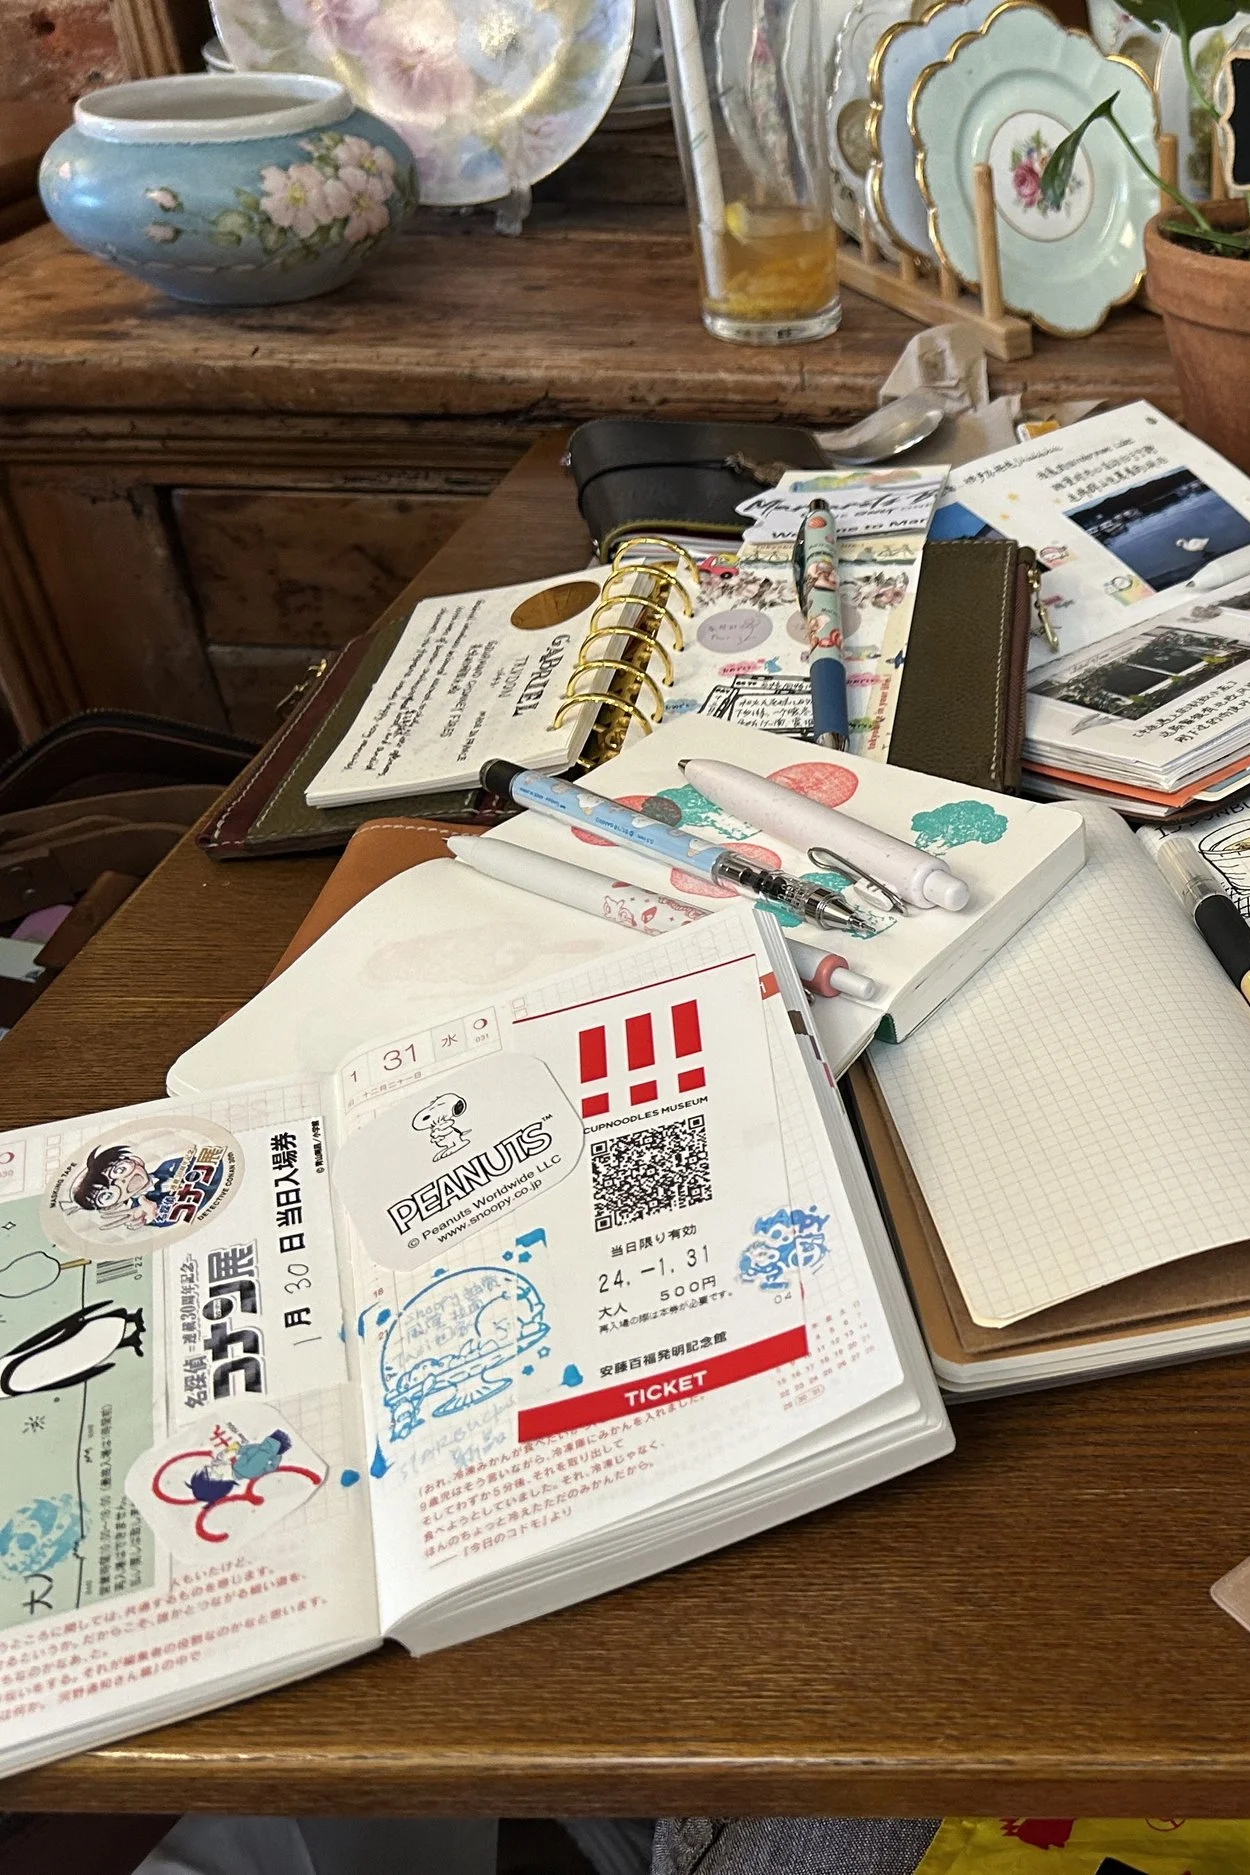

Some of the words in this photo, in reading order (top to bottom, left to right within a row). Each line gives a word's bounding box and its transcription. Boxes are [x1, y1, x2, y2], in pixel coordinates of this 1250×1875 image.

[513, 633, 570, 718] GABRIEL
[350, 1070, 358, 1083] 1
[382, 1043, 418, 1072] 31
[441, 1033, 458, 1048] 水
[583, 1110, 660, 1135] CUPNOODLES
[660, 1096, 710, 1115] MUSEUM
[50, 1175, 65, 1208] MASKING
[61, 1162, 77, 1180] TAPE
[197, 1186, 227, 1221] DETECTIVE
[225, 1165, 236, 1187] CONAN
[270, 1131, 303, 1228] 当日入場券
[387, 1121, 553, 1235] PEANUTS
[422, 1207, 472, 1241] Peanuts
[472, 1171, 536, 1210] Worldwide
[535, 1154, 562, 1177] LLC
[436, 1178, 543, 1245] www.snoopy.co.jp
[279, 1233, 306, 1253] 日
[610, 1223, 698, 1258] 当日限り有効
[686, 1244, 710, 1268] 31
[284, 1263, 312, 1294] 30
[203, 1241, 266, 1401] コナン展
[284, 1307, 312, 1328] 月
[598, 1303, 629, 1320] 大人
[599, 1331, 728, 1379] 安藤百福発明記念館
[184, 1353, 210, 1410] 名探偵
[624, 1370, 708, 1407] TICKET
